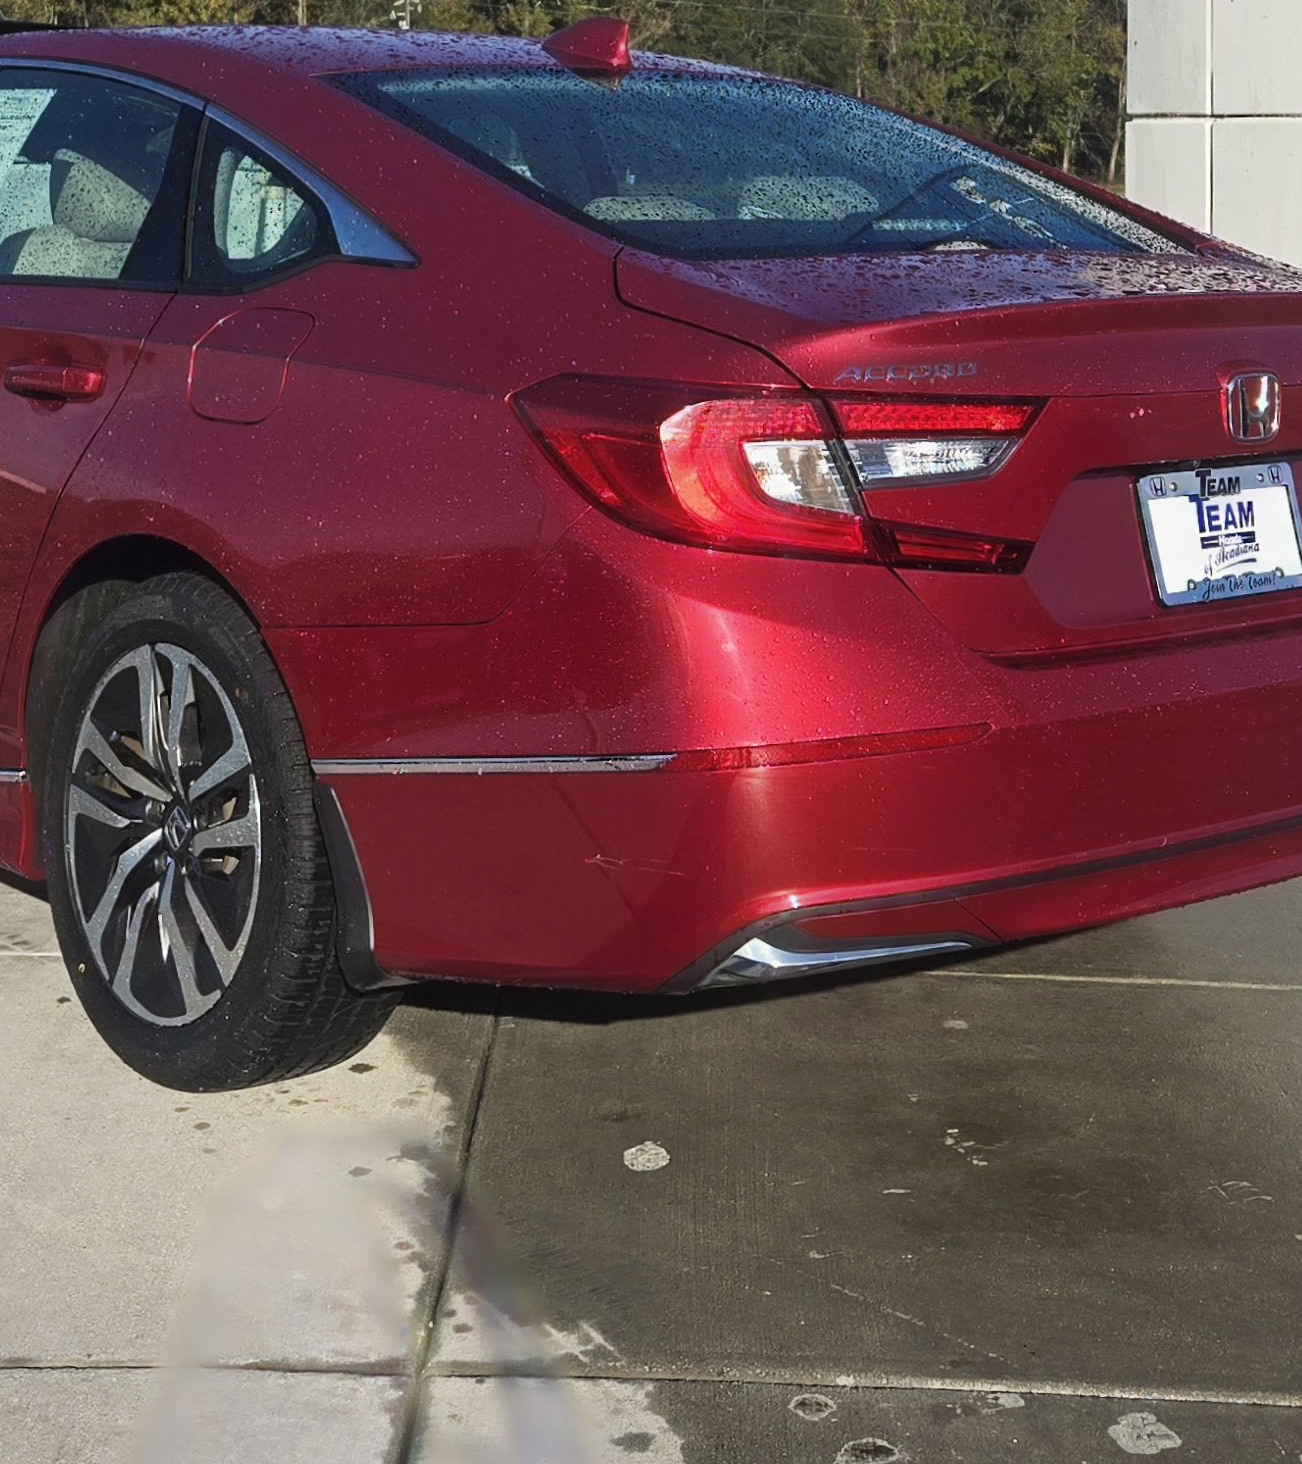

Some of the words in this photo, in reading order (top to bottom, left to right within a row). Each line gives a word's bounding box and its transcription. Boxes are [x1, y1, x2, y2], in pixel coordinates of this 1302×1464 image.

[834, 361, 979, 382] ACCORD
[1195, 469, 1241, 498] TEAM
[1188, 495, 1256, 533] TEAM
[1202, 577, 1226, 600] Join
